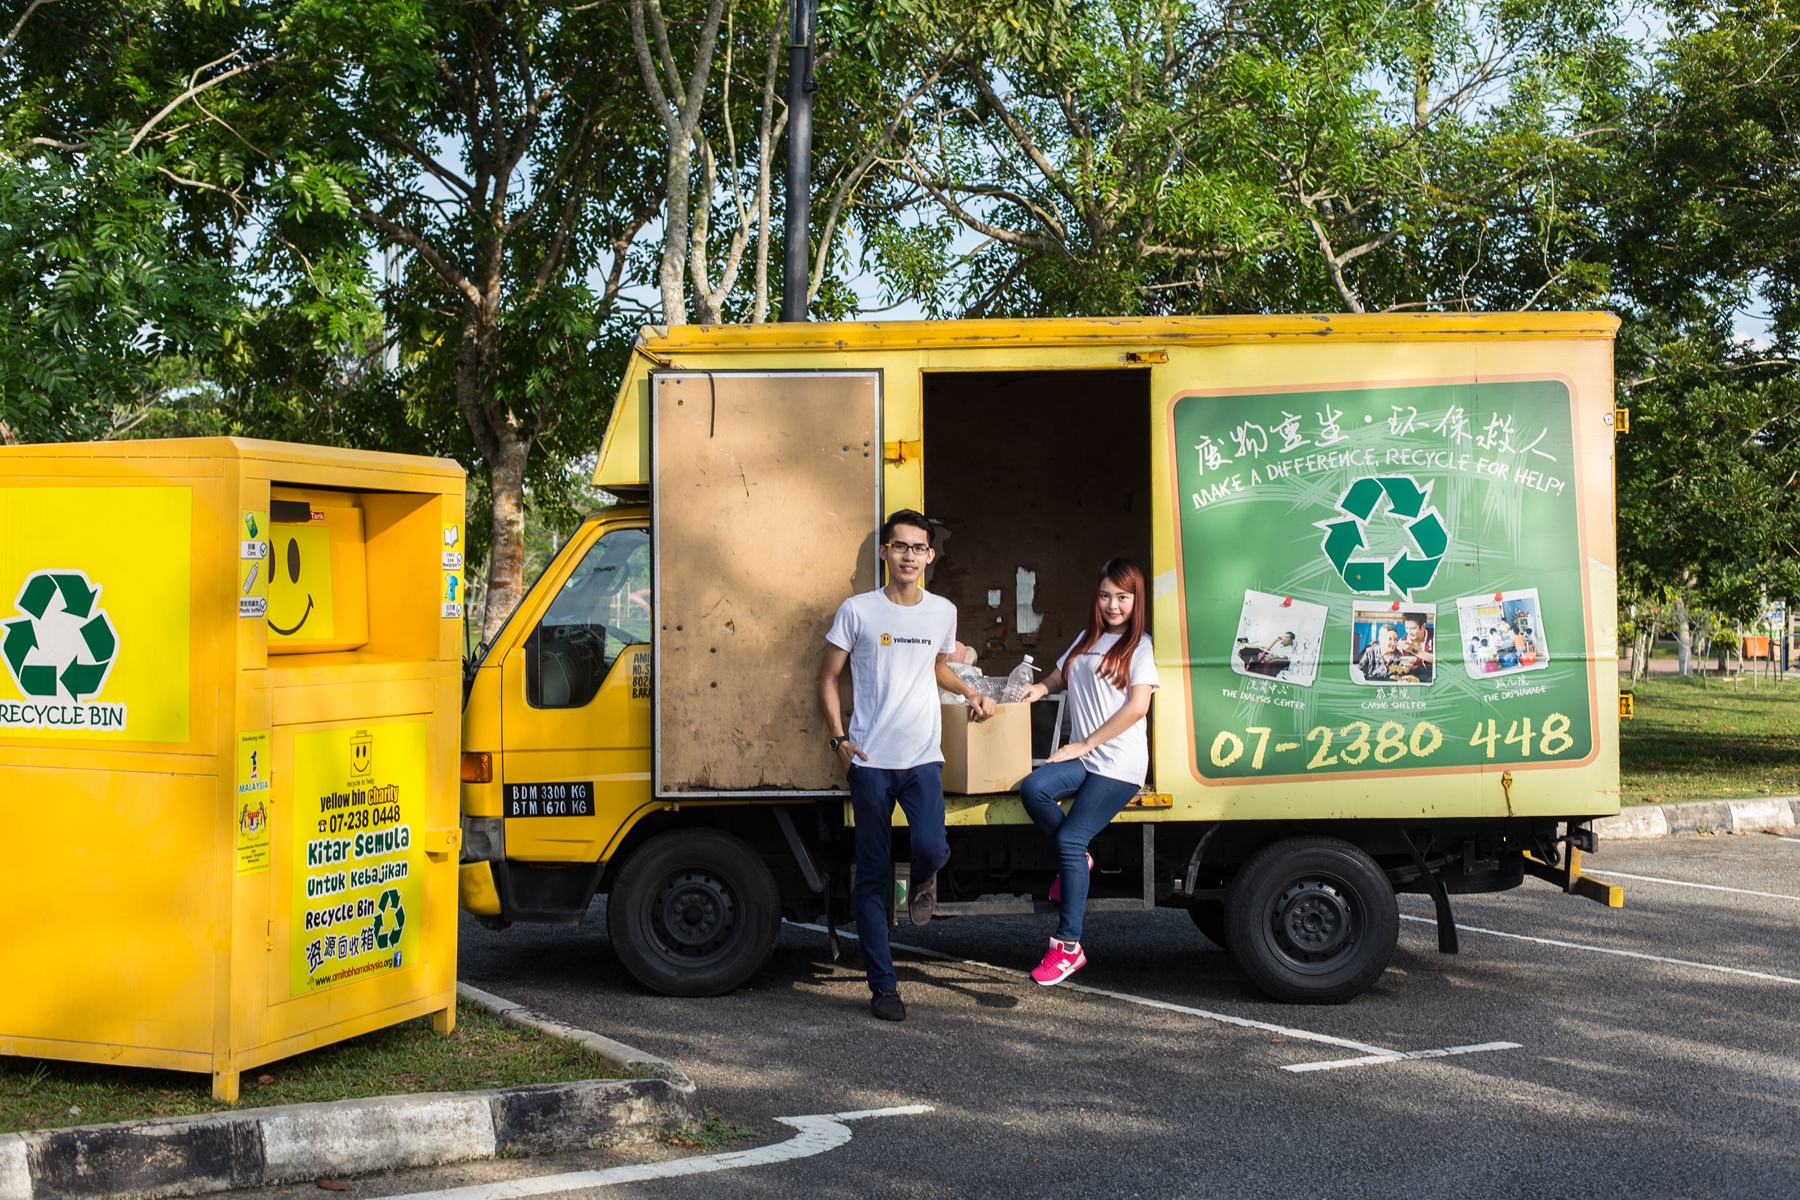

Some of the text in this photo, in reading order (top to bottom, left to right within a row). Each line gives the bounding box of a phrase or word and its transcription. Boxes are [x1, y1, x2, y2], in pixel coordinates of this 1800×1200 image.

[1192, 447, 1566, 509] MAKE A DIFFERENCE, RECYCLE FOR HELP!
[893, 636, 932, 646] yellowbin.org
[632, 664, 651, 676] NO.5
[632, 675, 651, 687] 802
[1222, 688, 1238, 699] THE
[1273, 697, 1306, 711] CENTER
[1483, 684, 1547, 702] THE ORPHANAGE
[0, 703, 123, 727] RECYCLE BIN
[1361, 701, 1427, 710] CARING SHELTER
[1210, 712, 1574, 770] 07-2380 448
[238, 780, 269, 794] MALAYSIA
[346, 779, 361, 789] recycle
[512, 784, 587, 800] BDM 3300 KG
[320, 783, 400, 813] yellow bin charity
[512, 800, 587, 816] BTM 1670 KG
[329, 804, 401, 834] 07-238 0448
[307, 838, 352, 867] Kitar
[354, 825, 410, 858] Semula
[307, 861, 409, 897] Untuk Kebajikan
[305, 898, 375, 931] Recycle Bin
